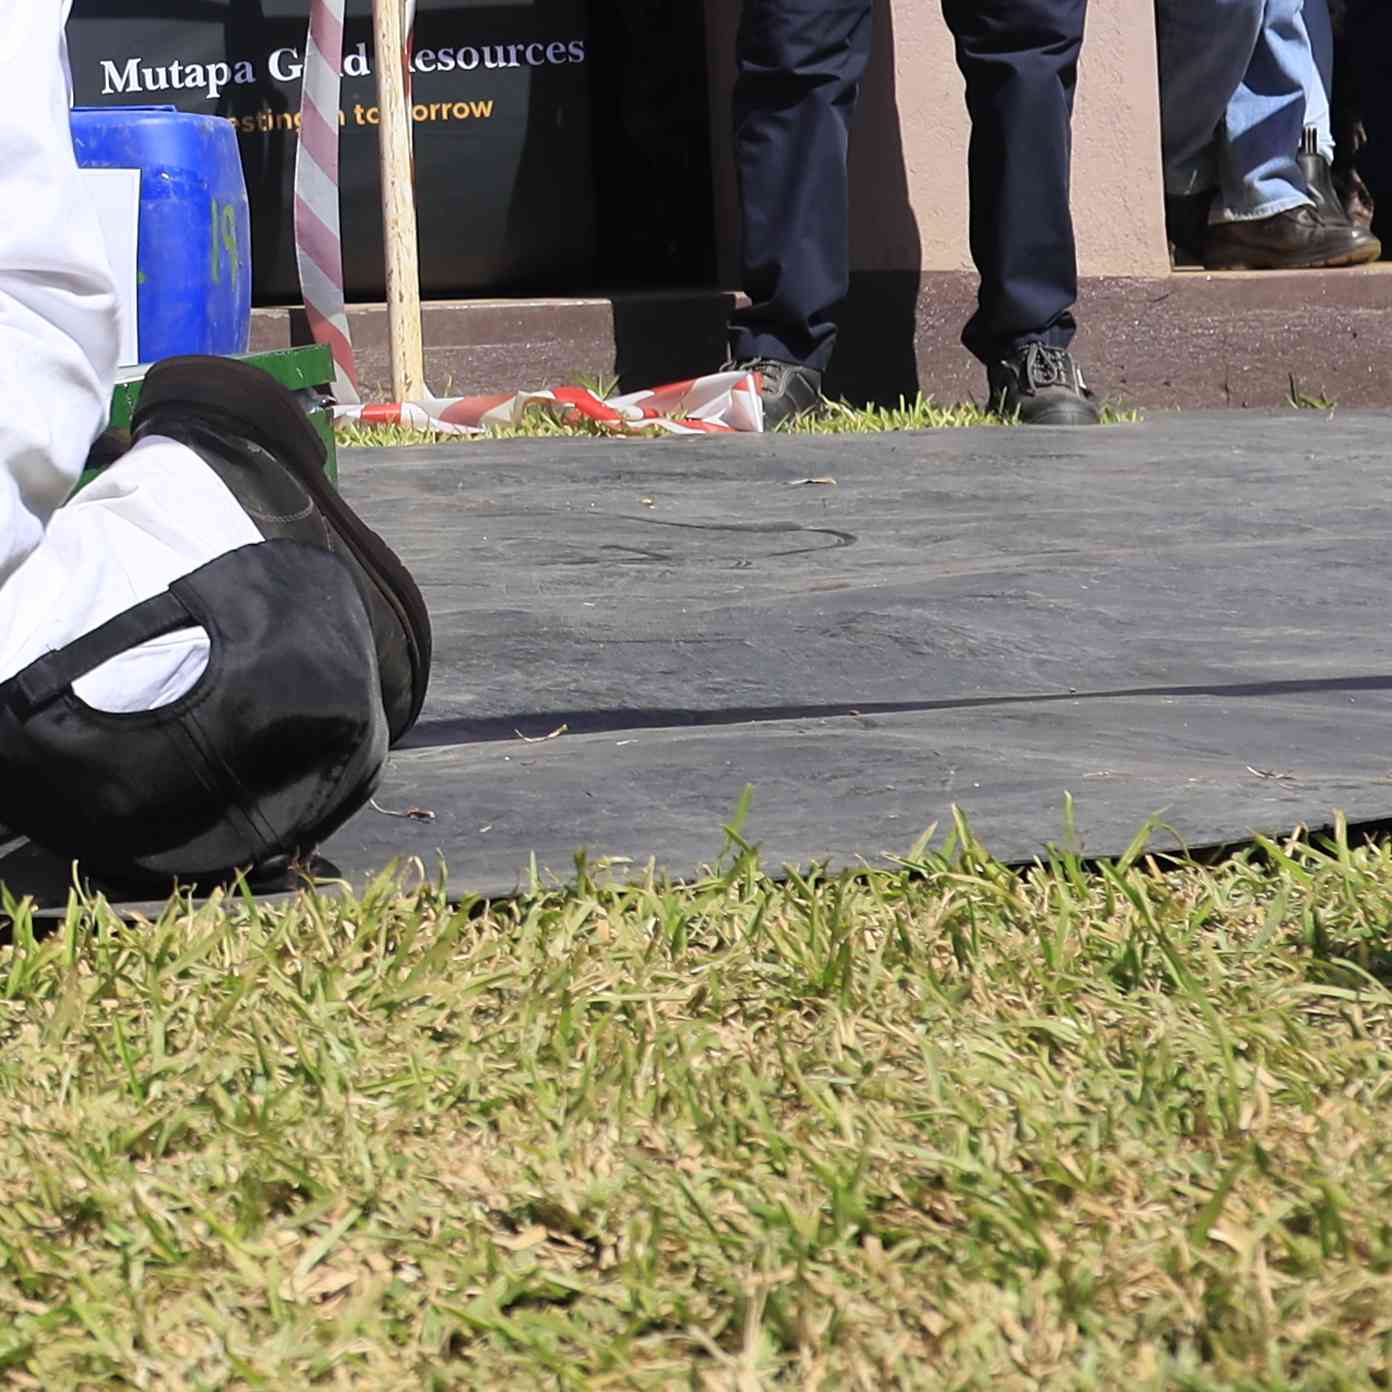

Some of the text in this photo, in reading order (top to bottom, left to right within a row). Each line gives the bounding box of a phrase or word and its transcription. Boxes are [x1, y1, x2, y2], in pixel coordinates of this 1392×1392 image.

[100, 40, 585, 98] Mutapa Gd esources
[355, 99, 492, 126] toorrow
